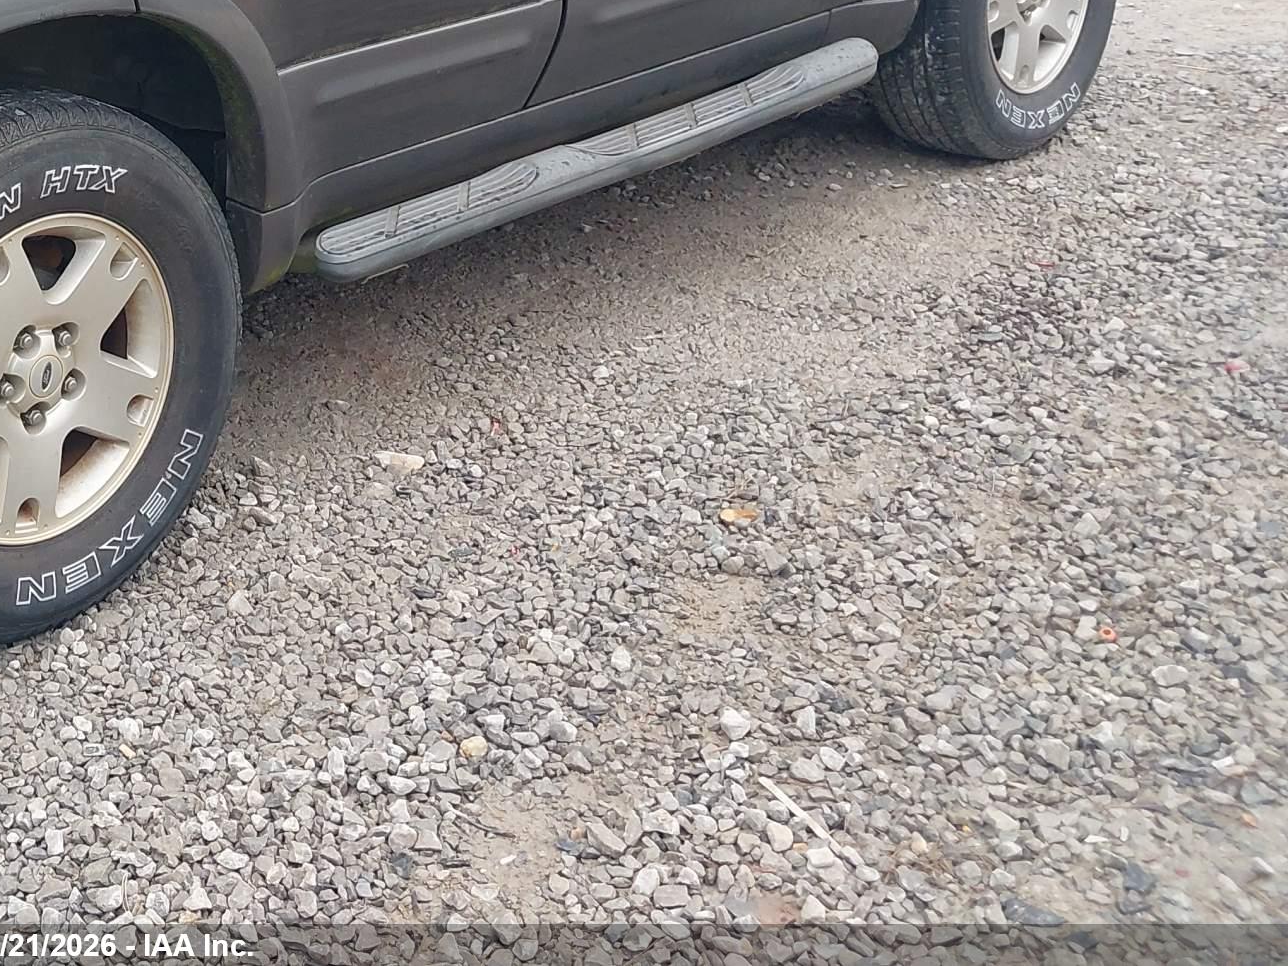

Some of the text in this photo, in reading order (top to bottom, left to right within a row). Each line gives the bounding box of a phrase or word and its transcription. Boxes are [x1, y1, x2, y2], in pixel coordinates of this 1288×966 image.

[995, 81, 1081, 129] NEXEN
[39, 164, 128, 199] HTX
[15, 428, 204, 607] NEXEN
